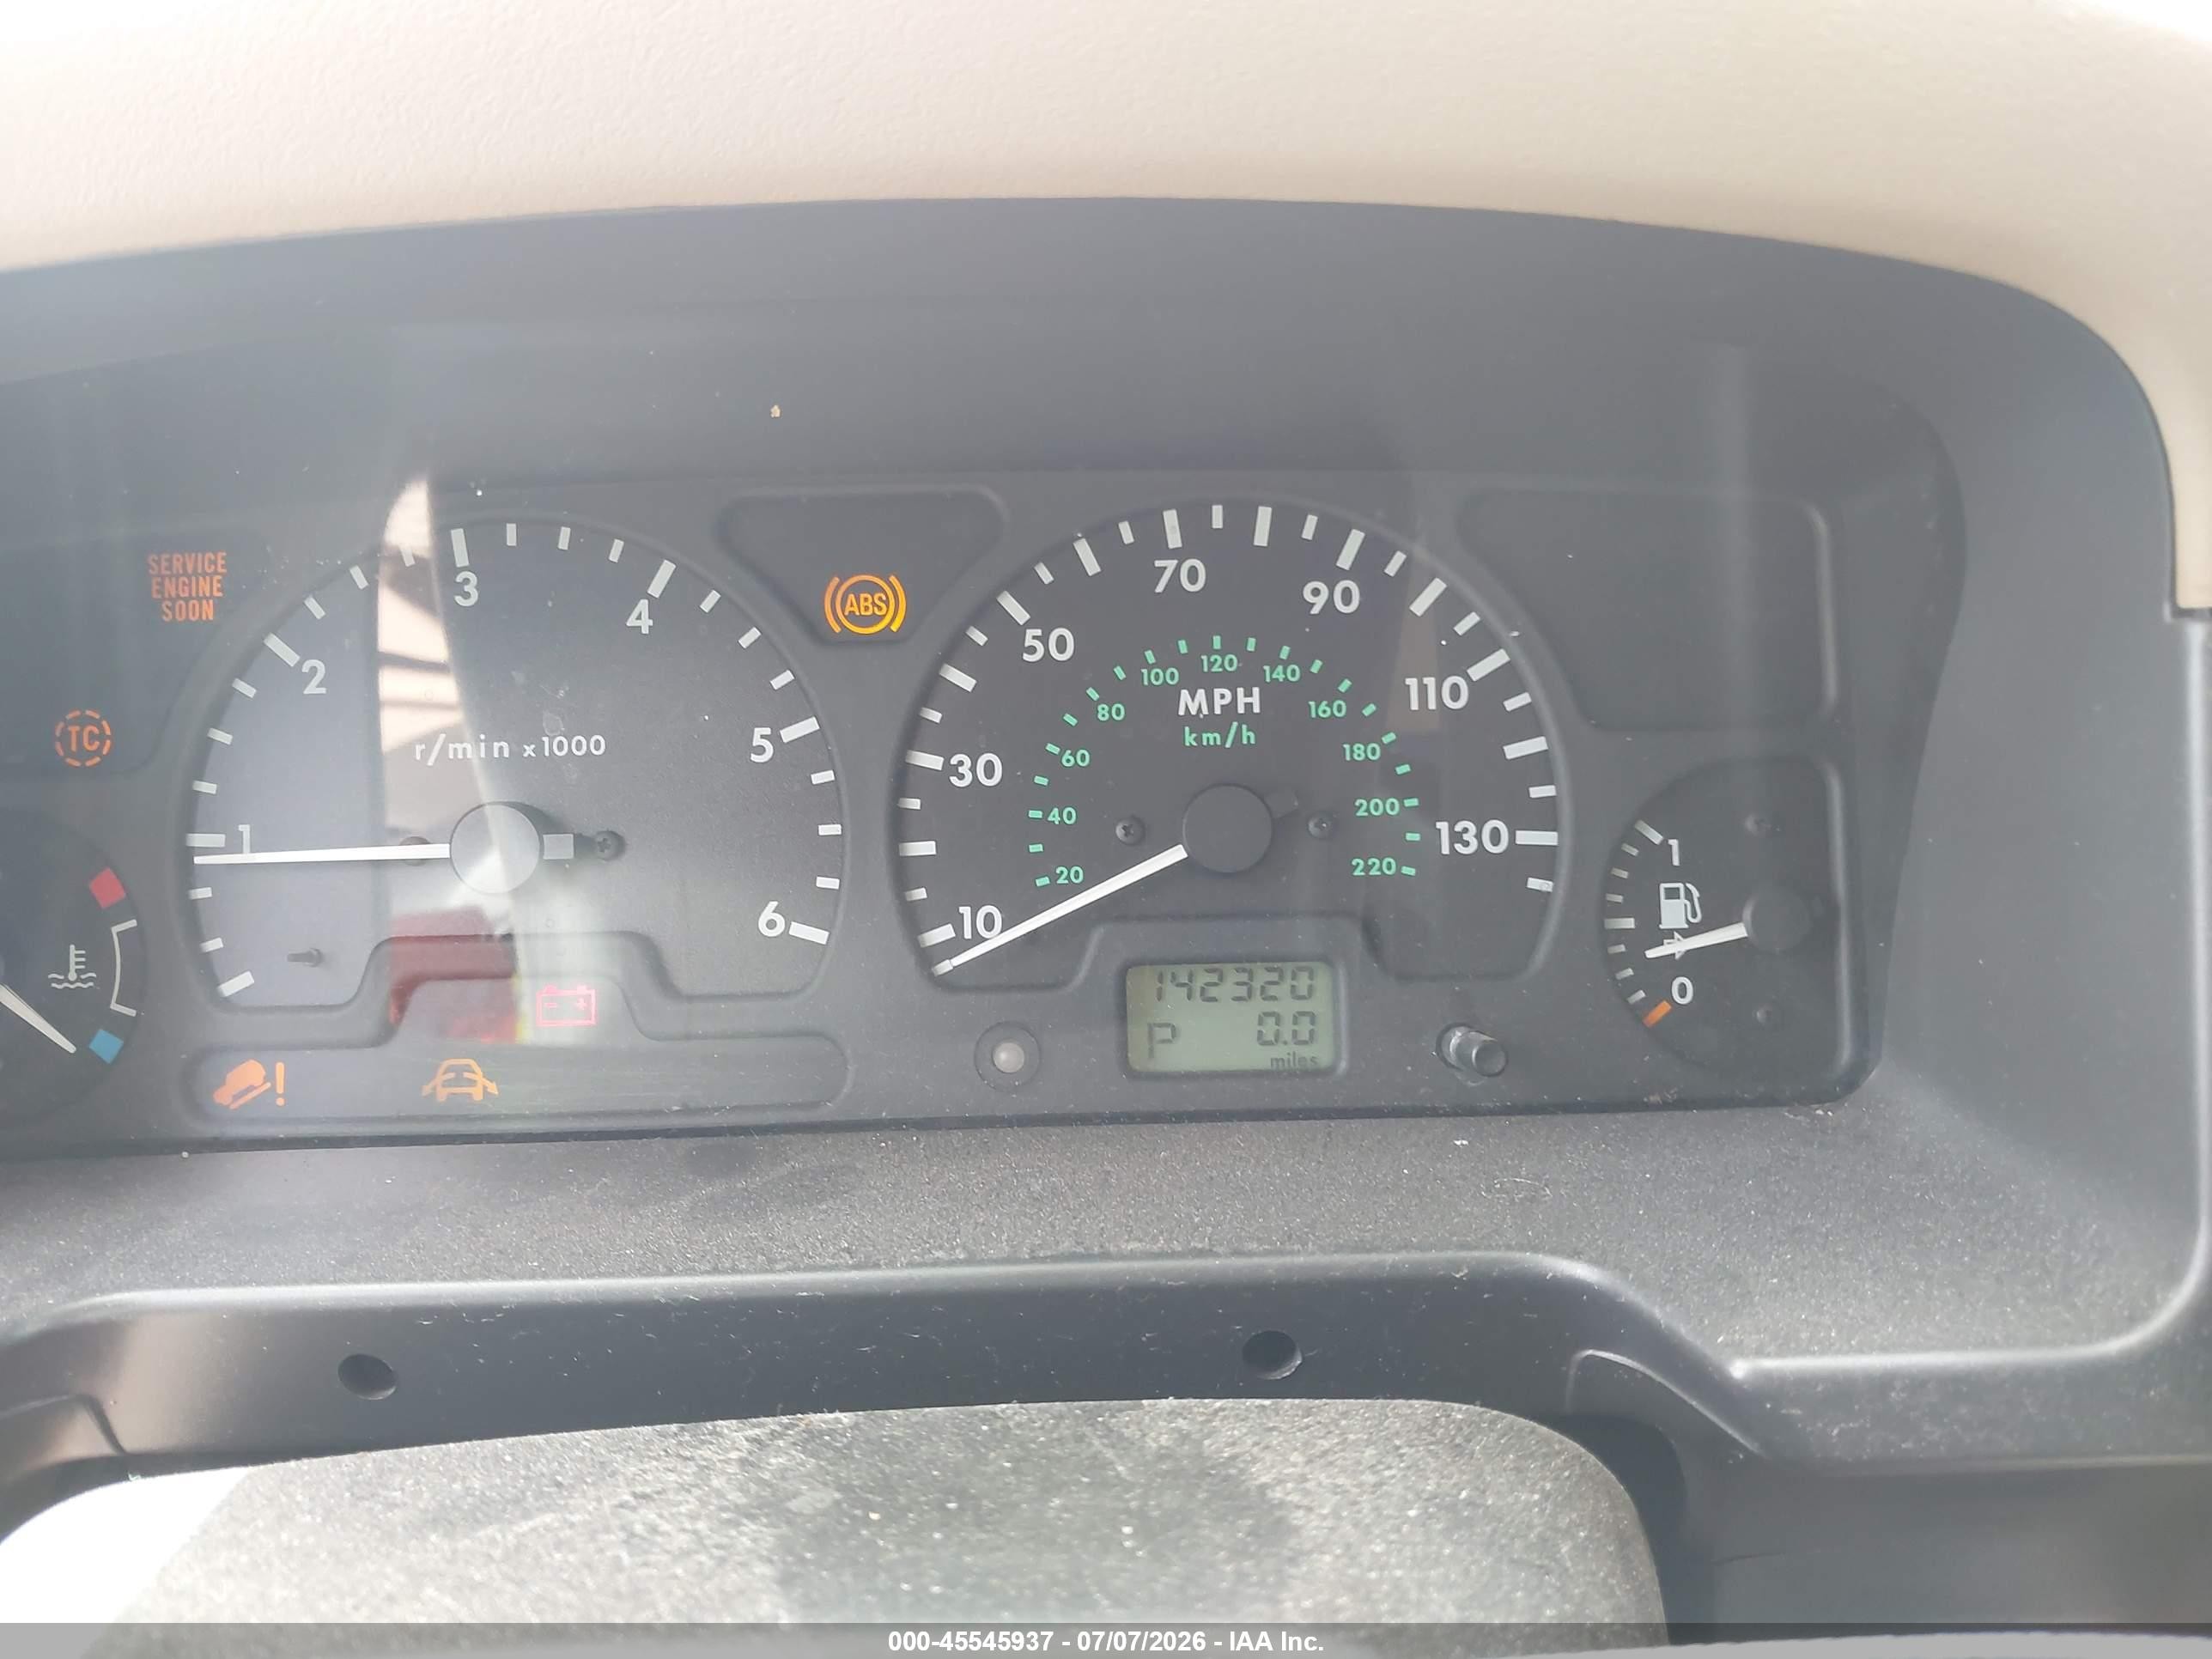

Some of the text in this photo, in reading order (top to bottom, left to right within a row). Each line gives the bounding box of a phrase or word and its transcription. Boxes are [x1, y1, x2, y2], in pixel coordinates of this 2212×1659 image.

[148, 552, 227, 576] SERVICE
[1154, 558, 1206, 593] 70
[152, 576, 223, 599] ENGINE
[453, 571, 478, 606] 3
[1302, 580, 1360, 615] 90
[161, 600, 214, 622] SOON
[626, 599, 653, 634] 4
[843, 592, 888, 617] ABS
[1022, 627, 1075, 663] 50
[301, 659, 326, 695] 2
[1141, 667, 1180, 686] 100
[1201, 654, 1238, 672] 120
[1263, 664, 1301, 683] 140
[1177, 686, 1261, 716] MPH
[1405, 675, 1469, 711] 110
[1097, 703, 1126, 721] 80
[1308, 700, 1347, 718] 160
[68, 725, 100, 752] TC
[750, 727, 774, 763] 5
[1184, 722, 1255, 748] km/h
[414, 735, 509, 766] r/min
[1060, 749, 1091, 768] 60
[1342, 743, 1382, 762] 180
[948, 752, 1004, 788] 30
[1047, 807, 1077, 825] 40
[1354, 799, 1401, 817] 200
[238, 823, 251, 854] 1
[1435, 819, 1510, 855] 130
[1668, 838, 1680, 866] 1
[1054, 866, 1085, 884] 20
[1351, 858, 1397, 877] 220
[757, 901, 785, 937] 6
[958, 904, 1003, 939] 10
[1156, 966, 1315, 1003] 142320
[1670, 975, 1694, 1006] 0
[1146, 1011, 1318, 1059] P 0.0
[1269, 1052, 1319, 1070] miles
